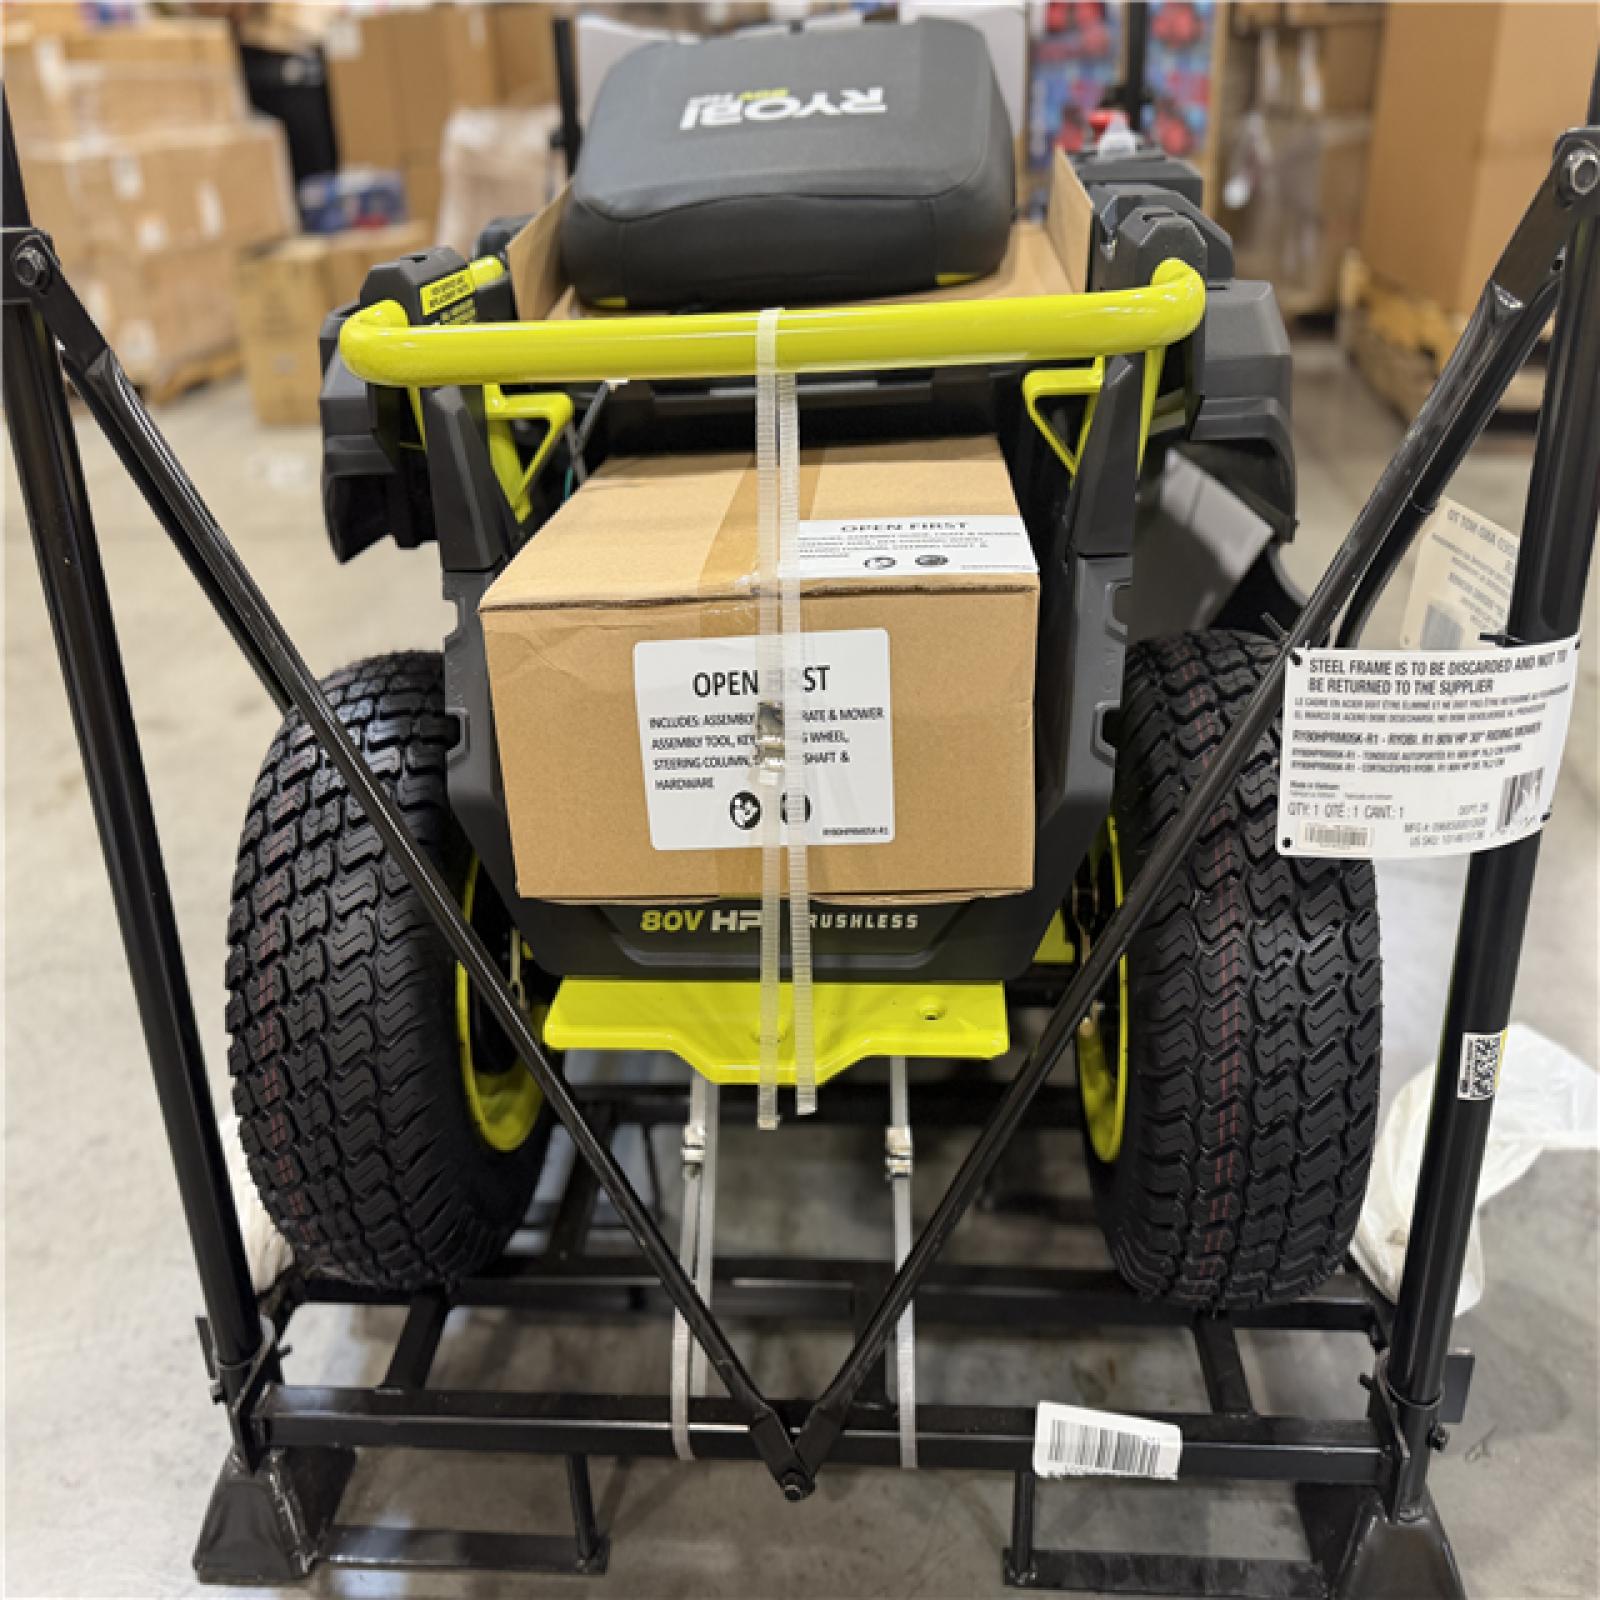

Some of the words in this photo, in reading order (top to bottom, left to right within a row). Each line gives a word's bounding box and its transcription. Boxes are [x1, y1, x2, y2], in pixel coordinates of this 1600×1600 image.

[1310, 659, 1345, 674] STEEL
[1349, 660, 1392, 676] FRAME
[1395, 661, 1408, 676] IS
[1411, 661, 1426, 676] TO
[1429, 661, 1445, 676] BE
[1448, 658, 1513, 676] DISCARDED
[1515, 654, 1535, 671] AND
[693, 669, 759, 698] OPEN
[1309, 677, 1324, 692] BE
[1327, 679, 1391, 695] RETURNED
[1394, 680, 1411, 695] TO
[1414, 680, 1435, 695] THE
[1439, 678, 1494, 696] SUPPLIER
[829, 708, 838, 721] &
[839, 707, 884, 722] MOWER
[652, 736, 702, 751] ASSEMBLY
[654, 756, 701, 771] STEERING
[654, 776, 715, 791] HARDWARE
[640, 910, 704, 933] 80V
